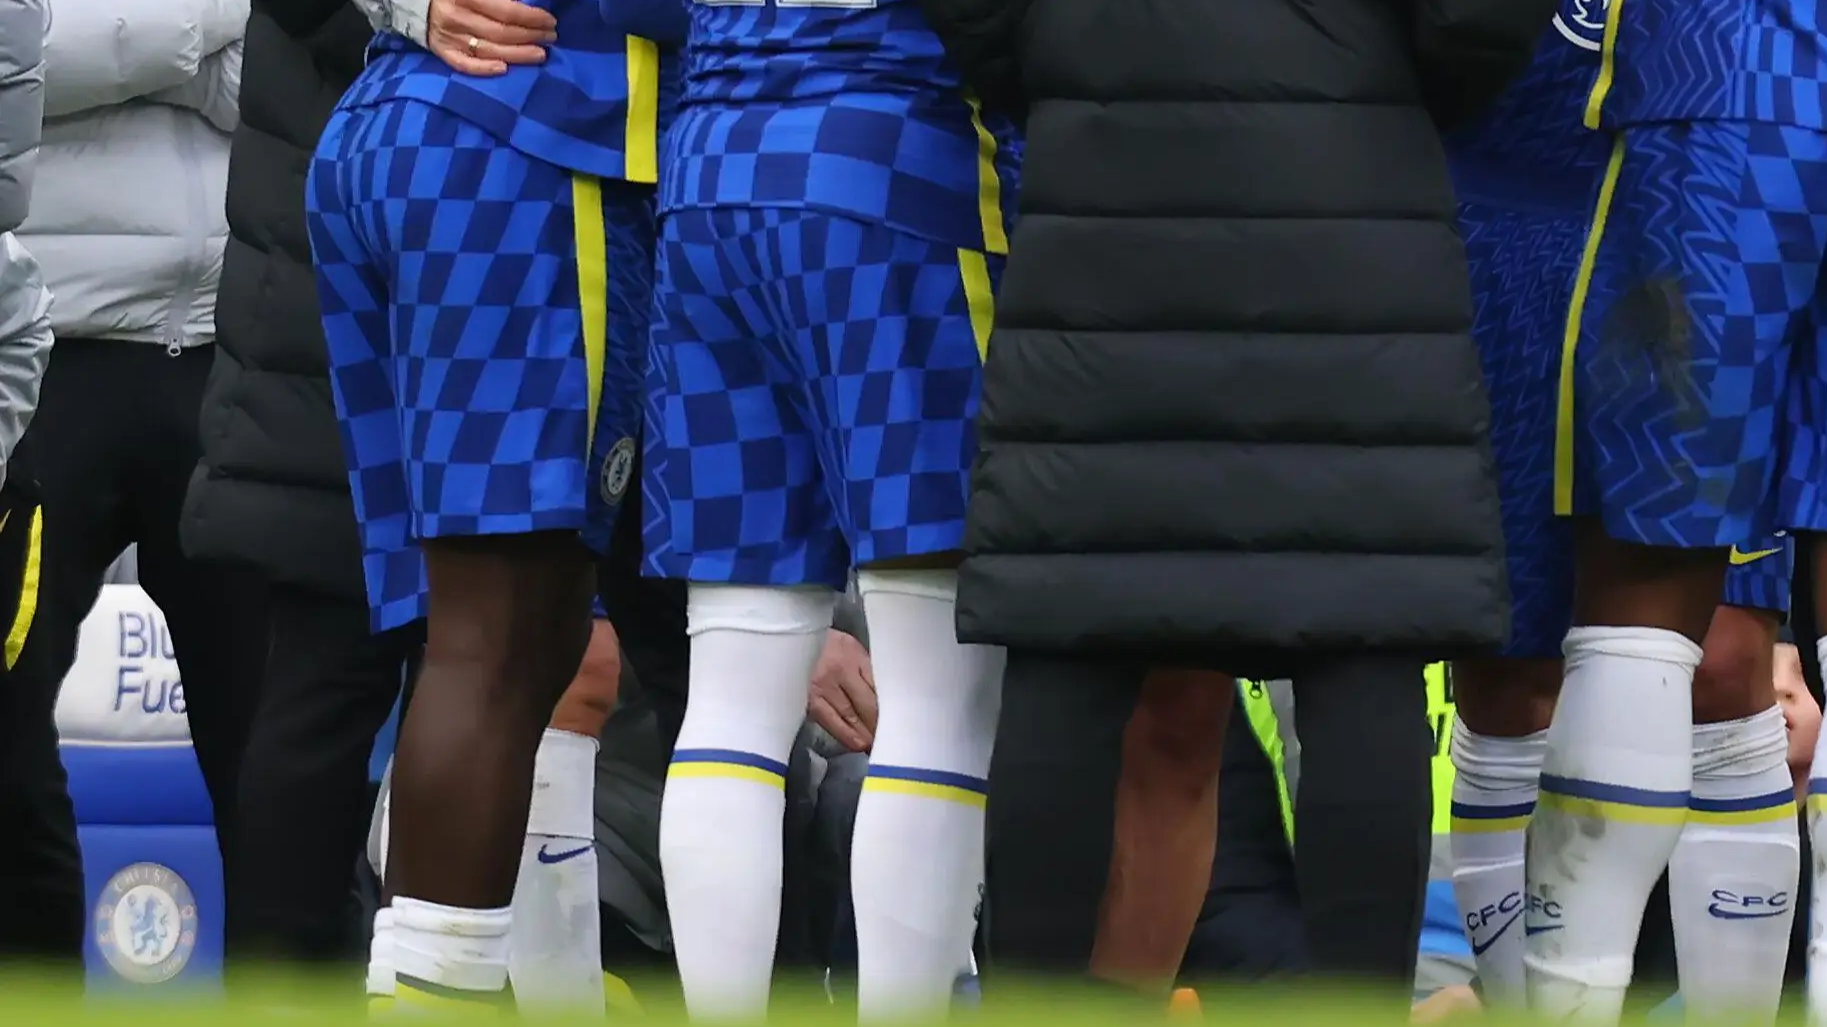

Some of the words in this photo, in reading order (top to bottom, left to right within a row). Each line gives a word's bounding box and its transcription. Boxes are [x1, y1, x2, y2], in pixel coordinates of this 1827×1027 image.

[119, 611, 176, 660] Blu
[114, 665, 187, 714] Fue
[1466, 891, 1522, 931] CFC
[1712, 889, 1788, 908] CFC
